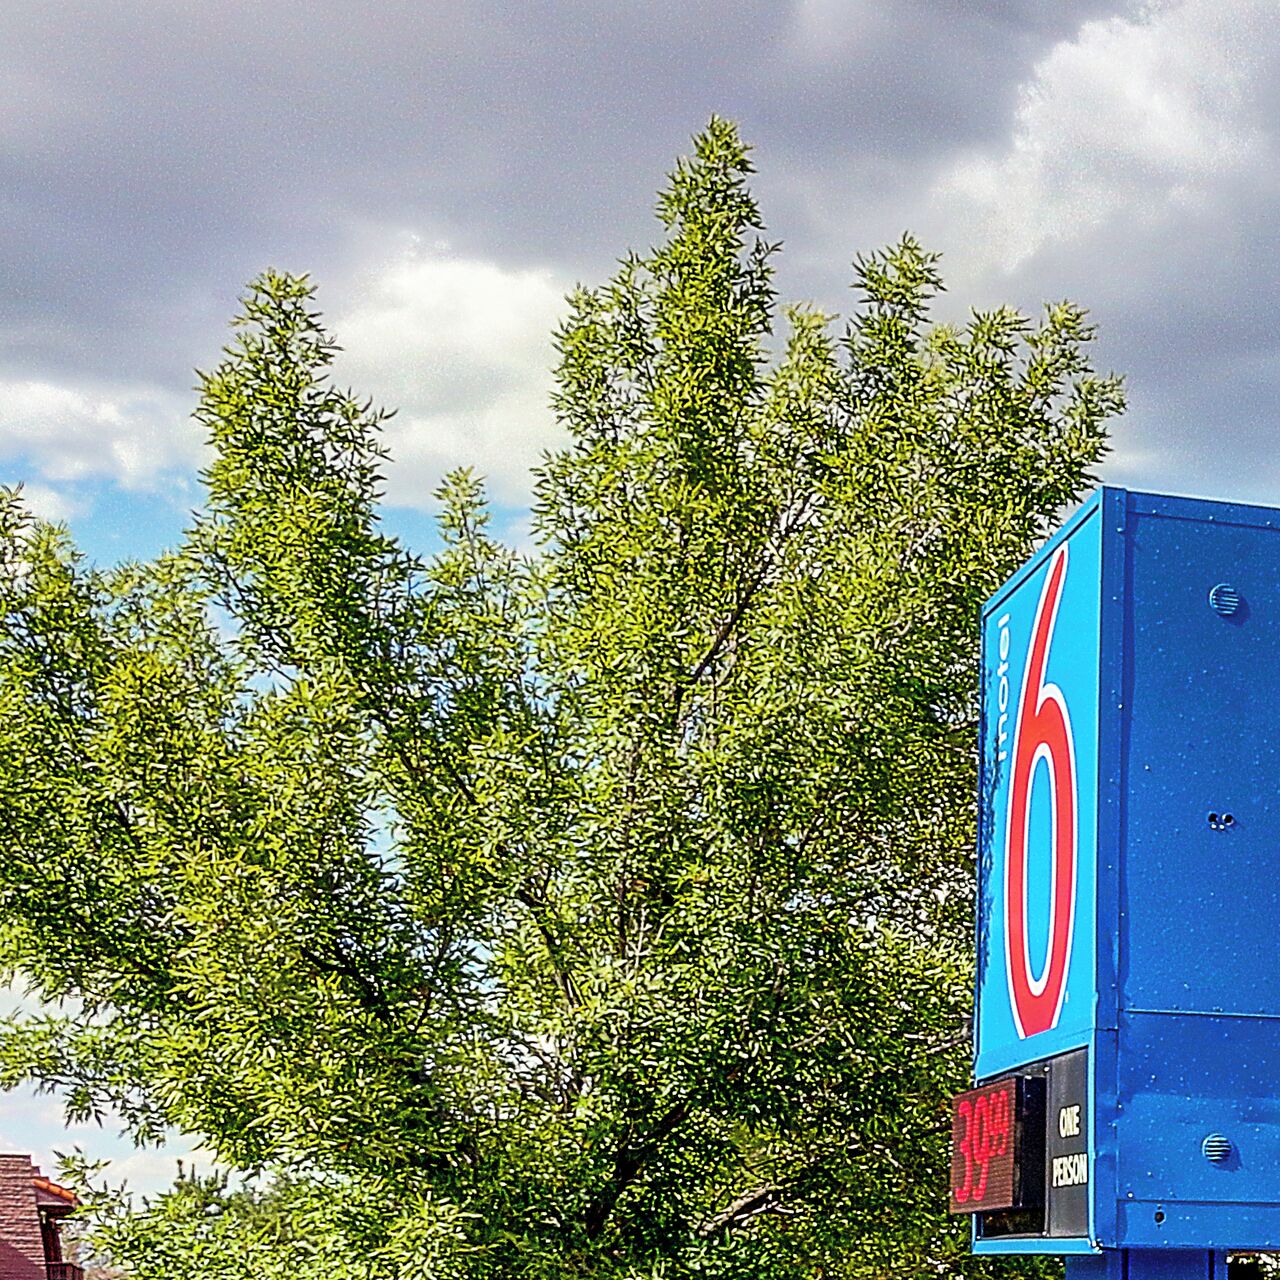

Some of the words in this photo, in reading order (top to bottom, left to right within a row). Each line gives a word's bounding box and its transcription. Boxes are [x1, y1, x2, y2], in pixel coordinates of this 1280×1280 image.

[997, 612, 1011, 763] motel
[1003, 540, 1078, 1041] 6
[1058, 1104, 1081, 1139] ONE
[1052, 1152, 1089, 1188] PERSON
